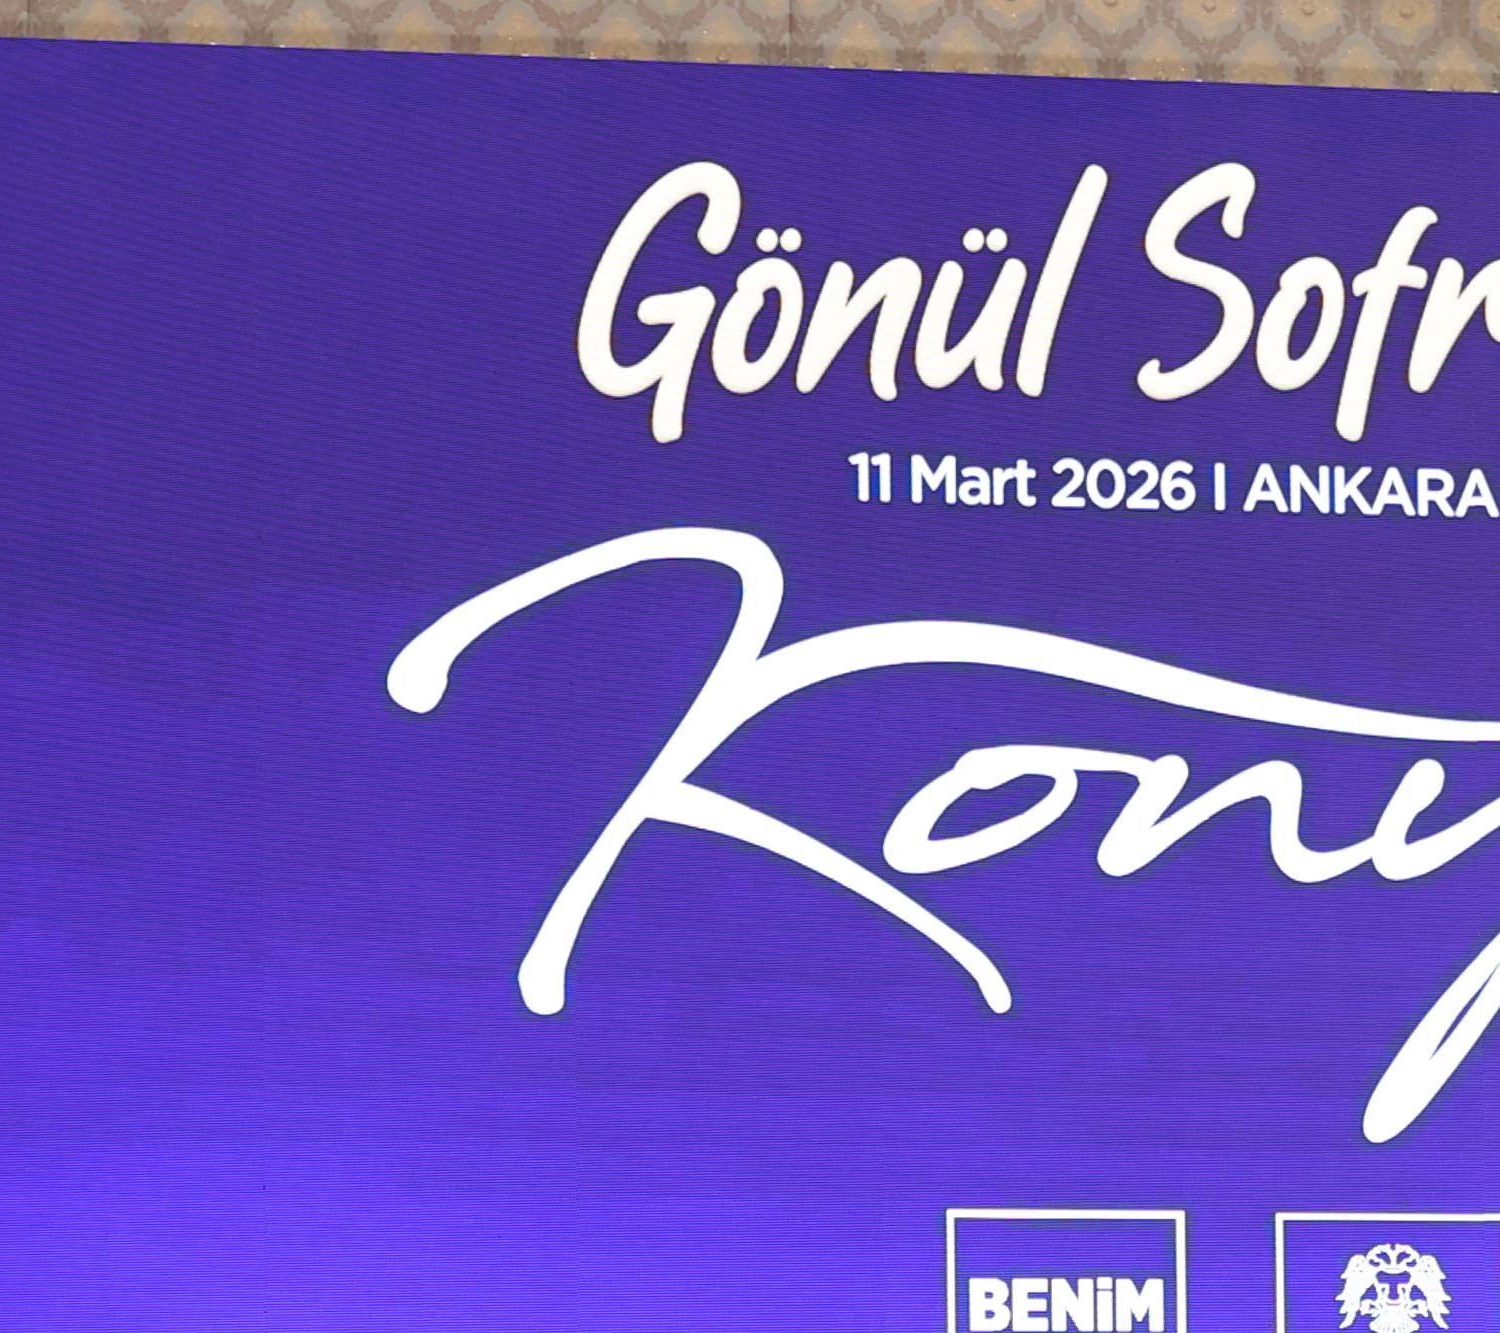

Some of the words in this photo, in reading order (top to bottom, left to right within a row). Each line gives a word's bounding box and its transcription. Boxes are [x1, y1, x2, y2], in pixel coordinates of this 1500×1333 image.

[575, 160, 1109, 444] Gönül
[847, 452, 892, 503] 11
[910, 454, 1038, 508] Mart
[1050, 457, 1197, 512] 2026
[1242, 462, 1500, 519] ANKARA
